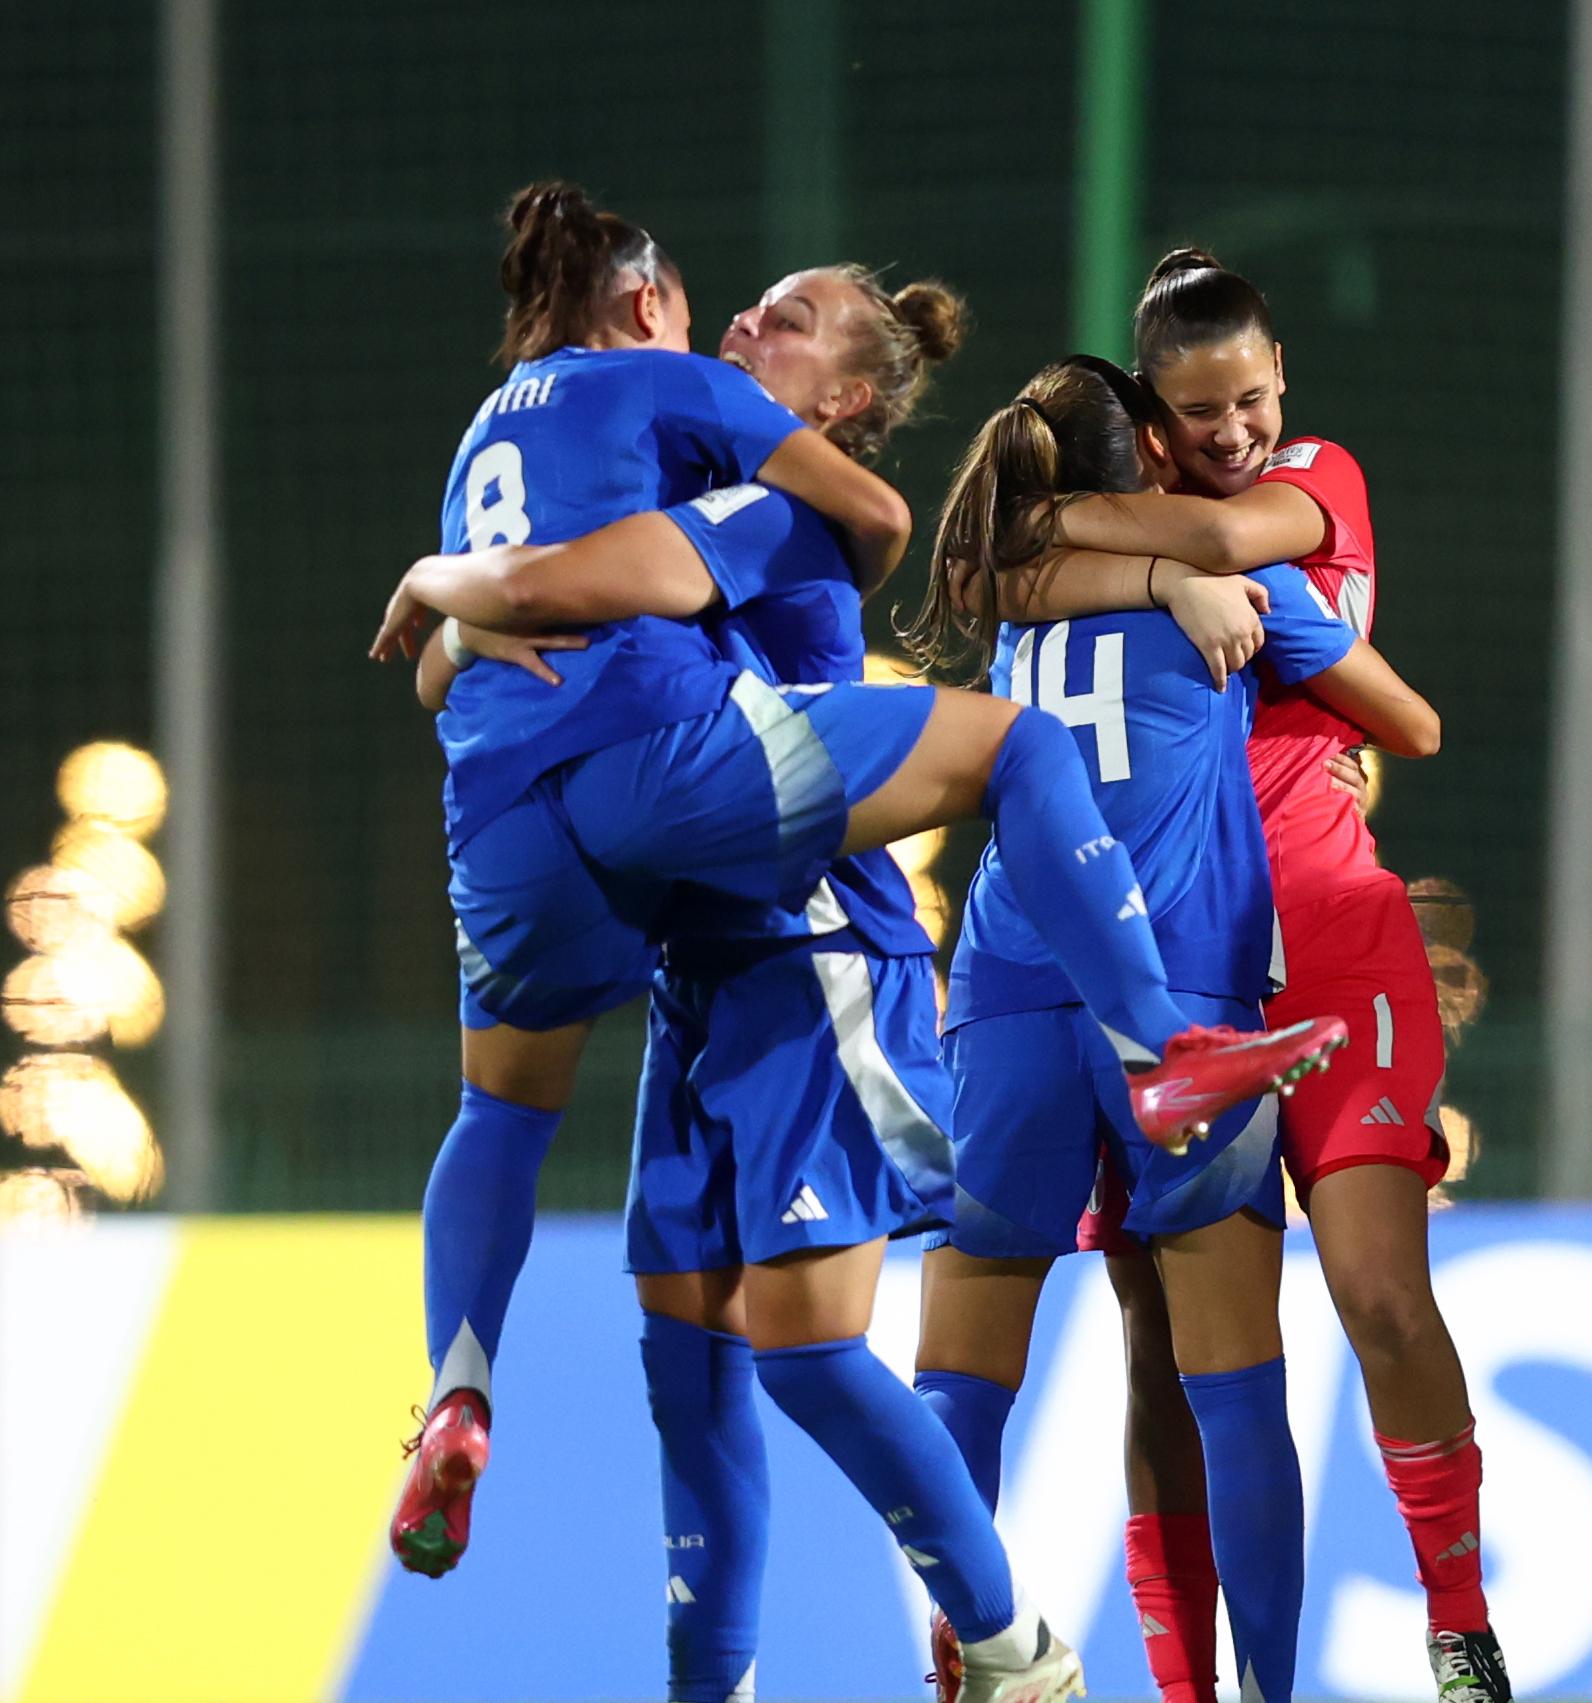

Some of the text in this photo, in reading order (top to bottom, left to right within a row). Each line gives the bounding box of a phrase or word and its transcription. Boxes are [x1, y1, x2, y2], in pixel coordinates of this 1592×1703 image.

[466, 440, 531, 553] 8
[1010, 619, 1132, 783] 14
[1373, 992, 1394, 1068] 1
